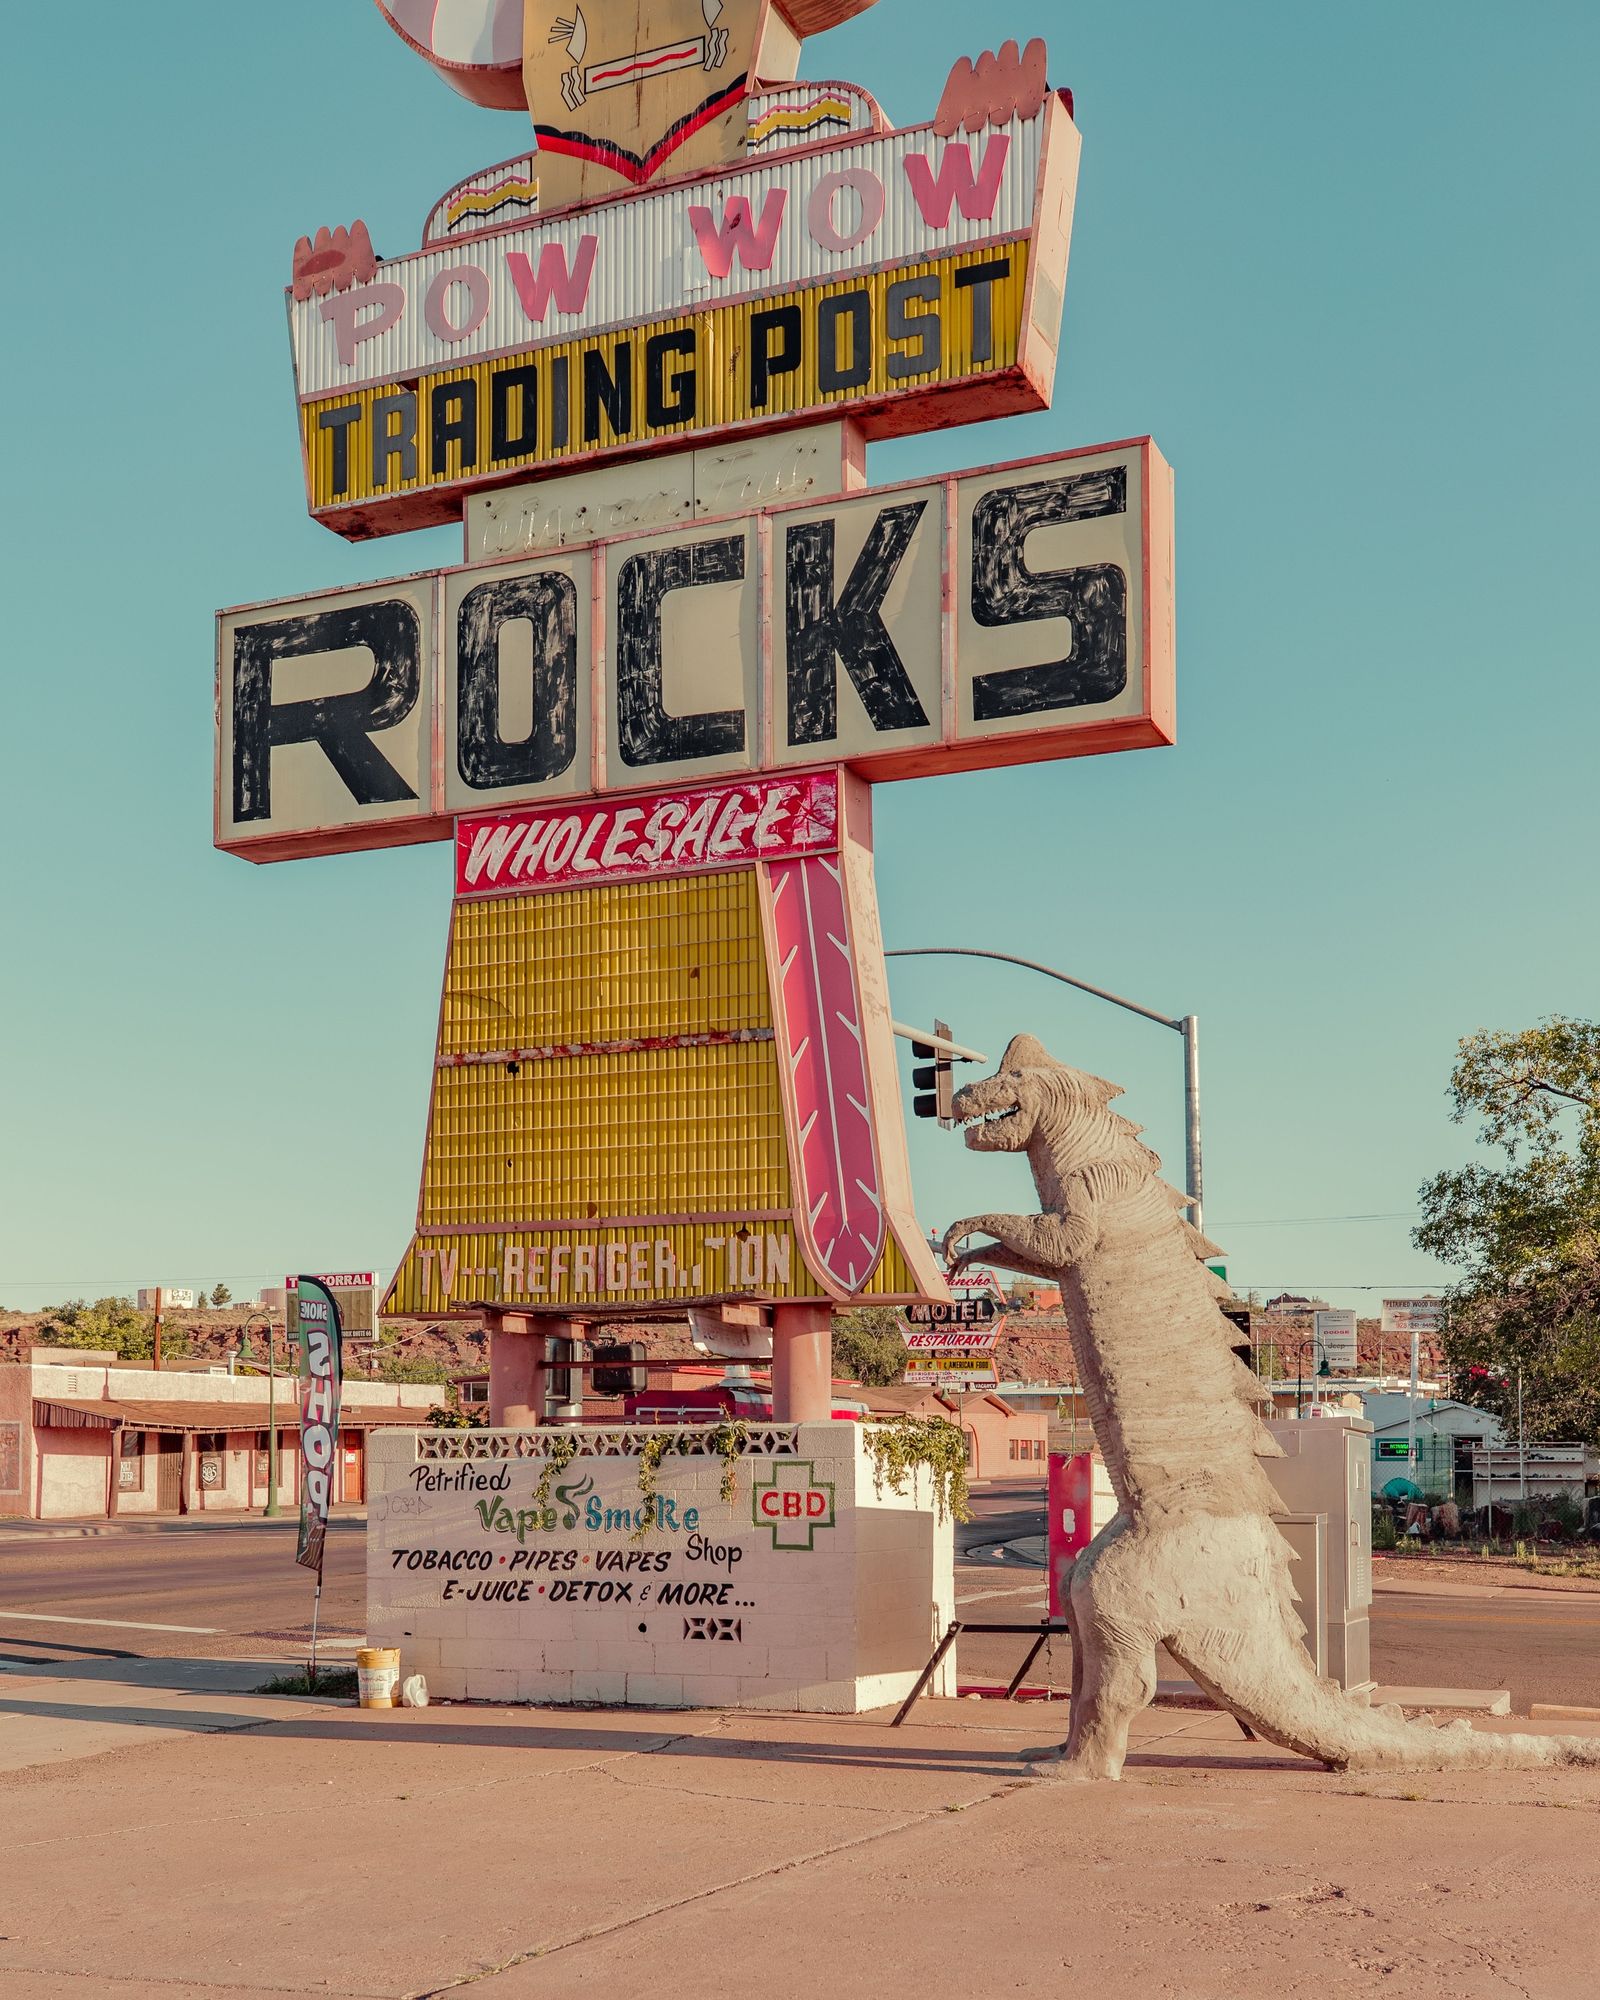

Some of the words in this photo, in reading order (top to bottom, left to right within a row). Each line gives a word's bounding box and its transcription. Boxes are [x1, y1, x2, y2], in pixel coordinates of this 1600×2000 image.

[319, 235, 598, 366] POW
[688, 133, 1010, 279] WOW
[319, 327, 696, 495] TRADING
[750, 258, 1010, 409] POST
[233, 464, 1127, 824] ROCKS
[464, 787, 801, 885] WHOLESALE
[911, 1300, 991, 1321] MOTEL
[908, 1333, 991, 1347] RESTAURANT
[949, 1361, 974, 1369] AMERICAN
[976, 1361, 989, 1369] FOOD
[409, 1462, 511, 1492] Petrified
[761, 1491, 827, 1517] CBD
[474, 1495, 558, 1545] Vape
[391, 1550, 493, 1571] TOBACCO
[508, 1550, 579, 1571] PIPES
[595, 1550, 672, 1572] VAPES
[685, 1533, 743, 1573] Shop
[442, 1580, 534, 1601] E-JUICE
[548, 1581, 632, 1602] DETOX
